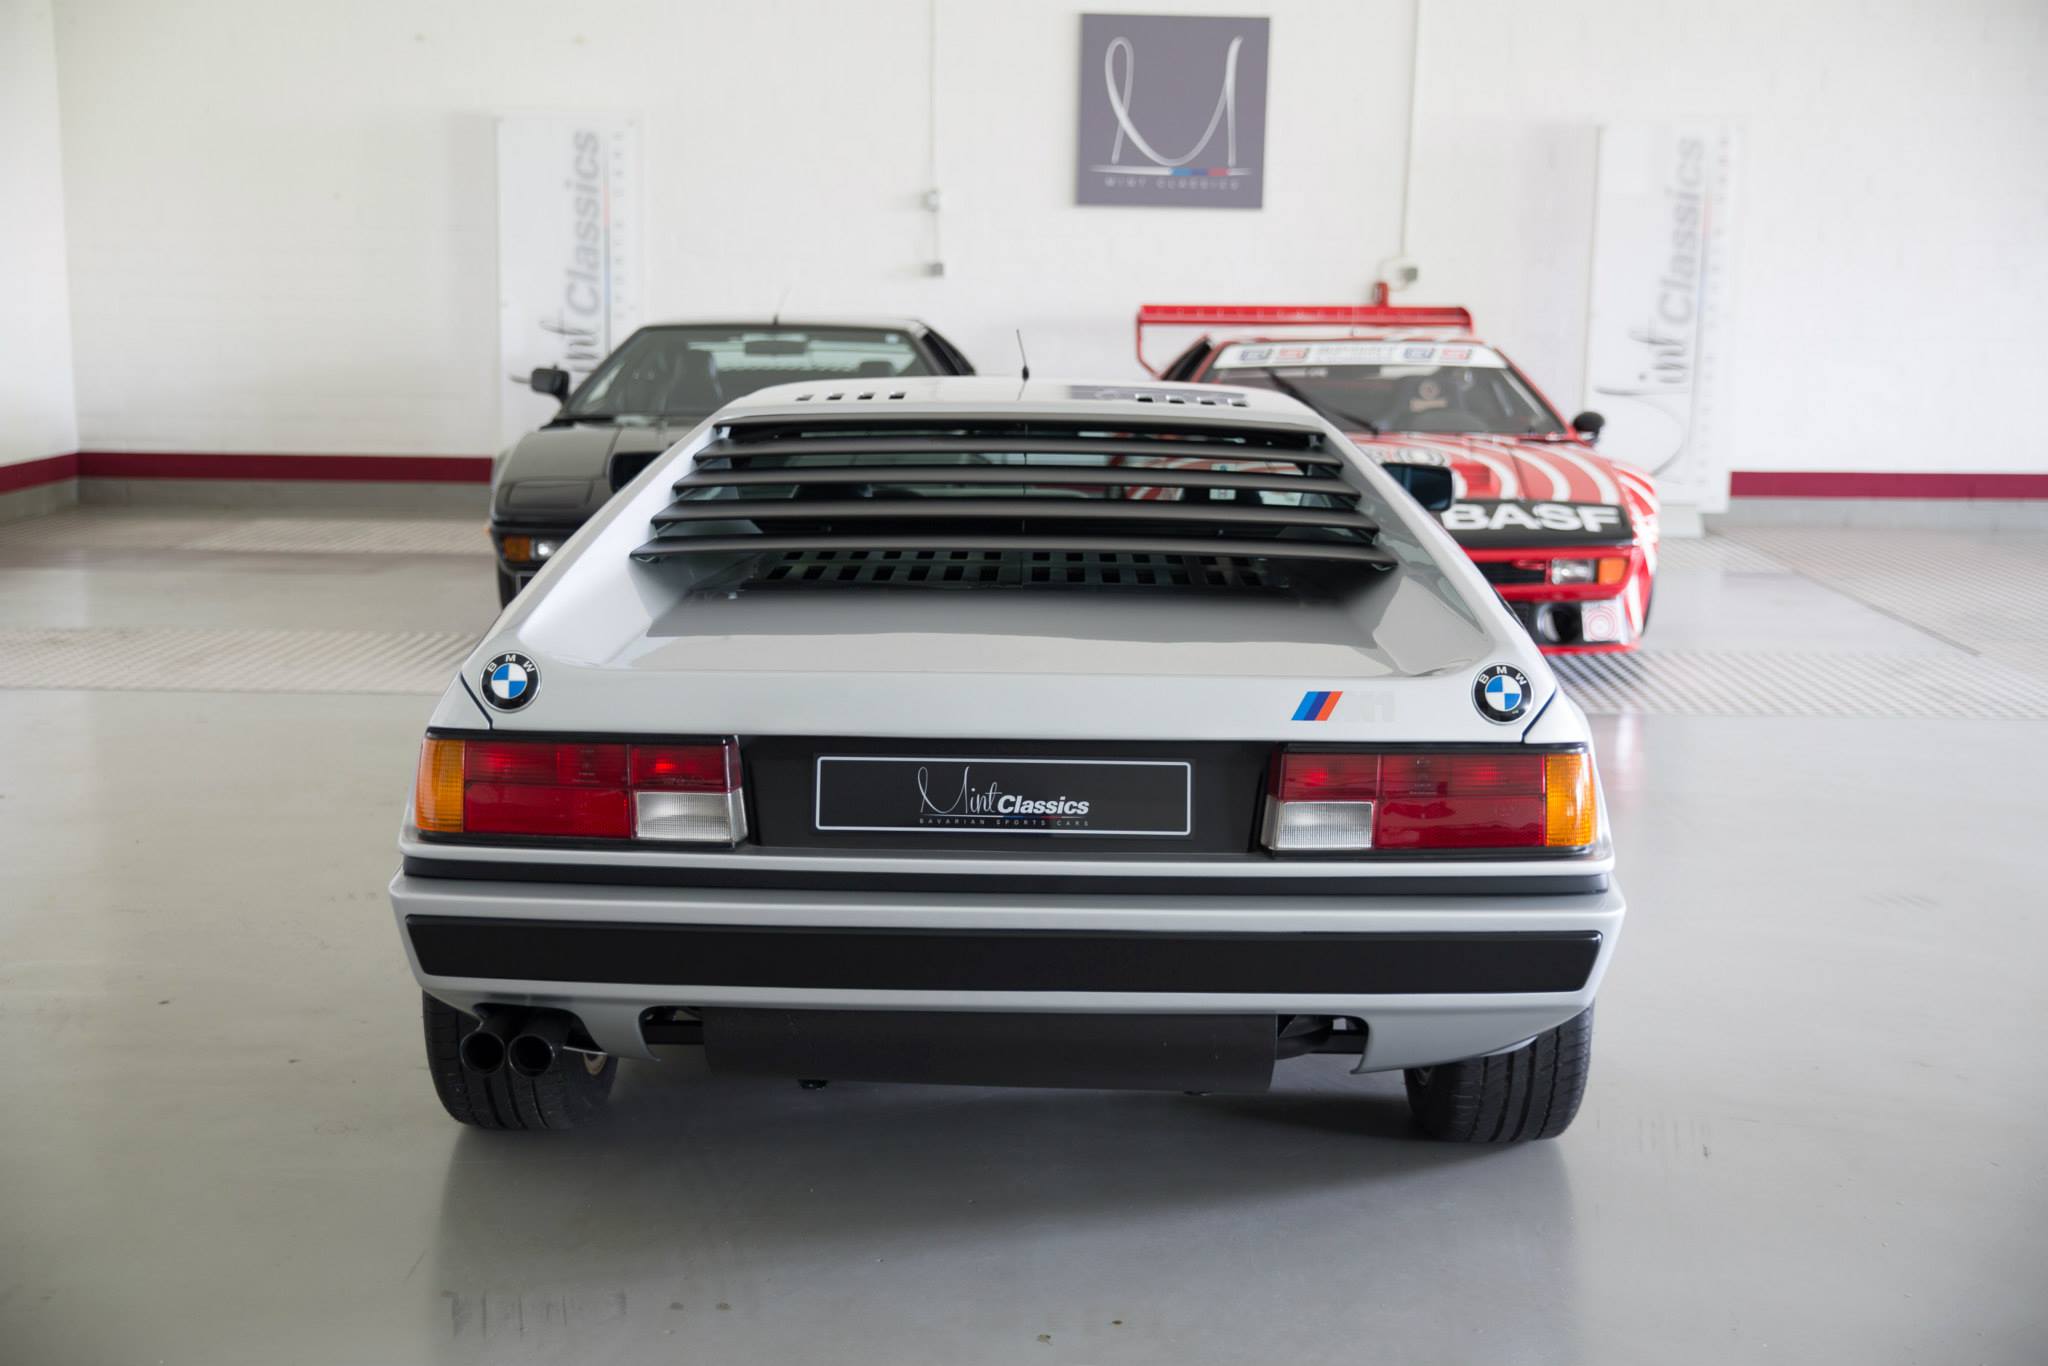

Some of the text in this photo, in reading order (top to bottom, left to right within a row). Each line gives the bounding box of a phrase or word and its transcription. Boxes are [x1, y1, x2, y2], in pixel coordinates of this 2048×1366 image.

[564, 129, 600, 317] Classics
[1656, 135, 1705, 326] Classics
[1440, 502, 1621, 533] BASF
[487, 654, 536, 673] BMW
[1479, 665, 1528, 685] BMW
[917, 766, 1090, 815] Mint Classics
[919, 818, 985, 826] BAVARIAN
[996, 819, 1046, 827] SPORTS
